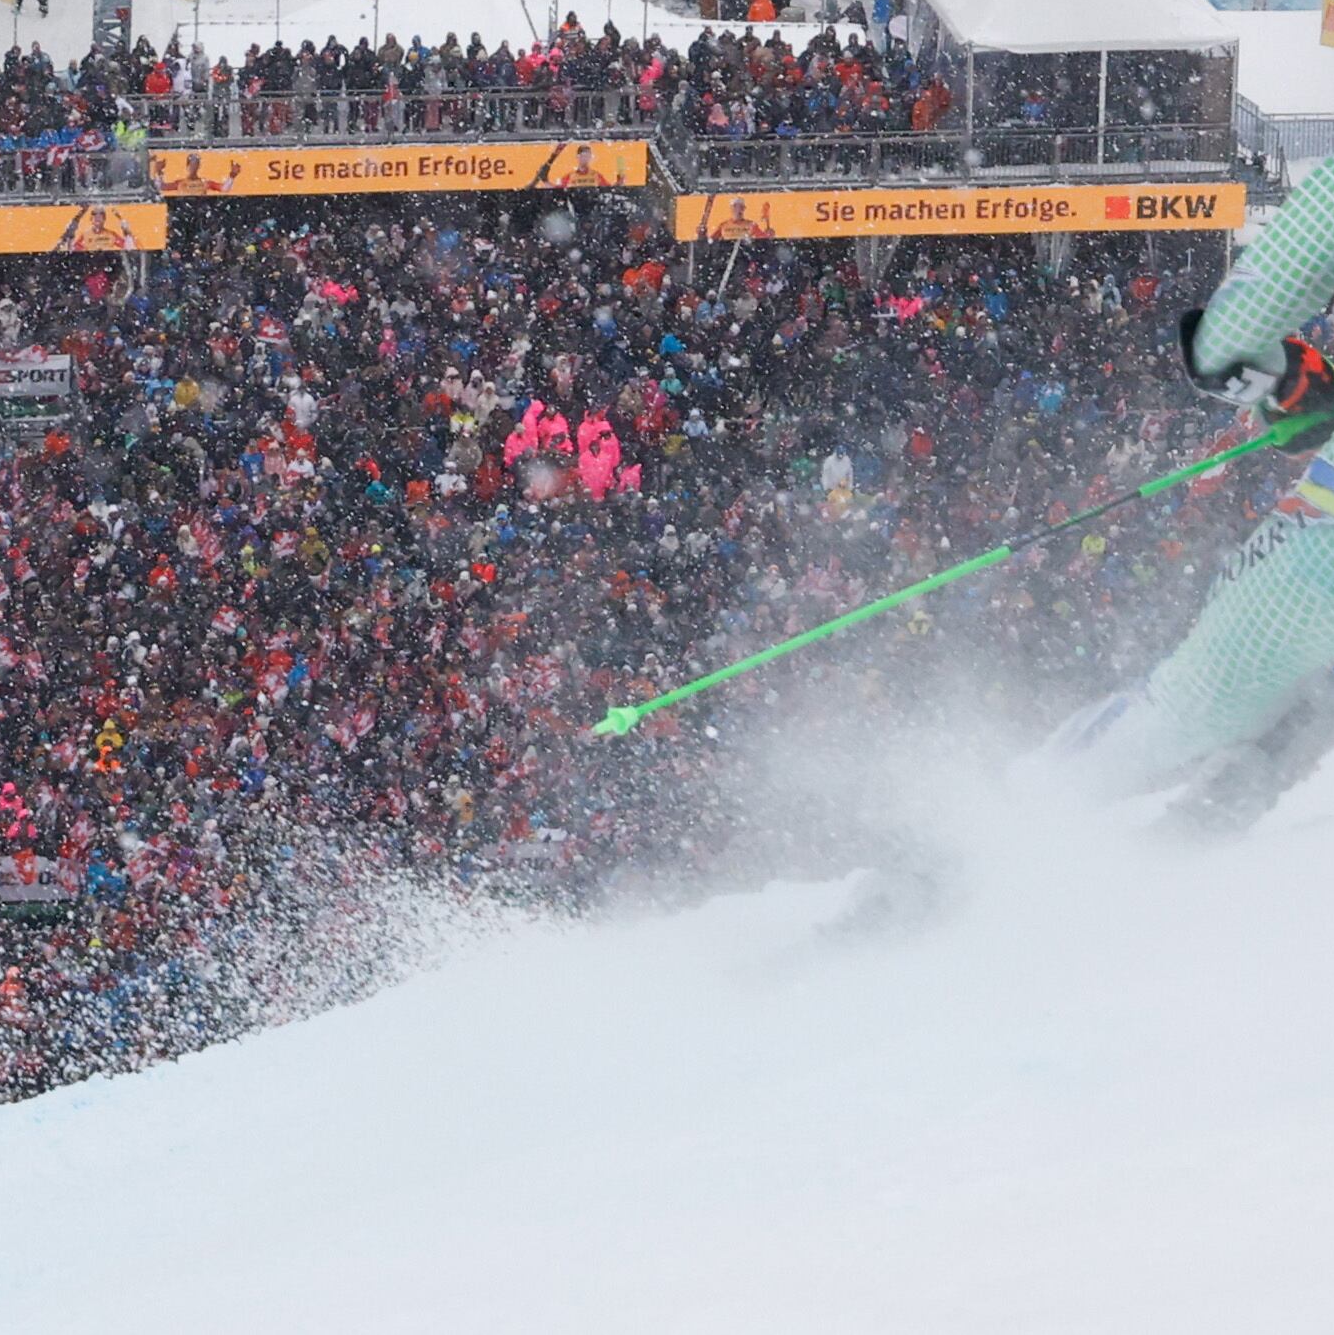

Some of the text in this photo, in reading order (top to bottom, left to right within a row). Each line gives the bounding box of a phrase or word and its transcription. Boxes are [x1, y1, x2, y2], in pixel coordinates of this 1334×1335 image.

[267, 155, 514, 180] Sie machen Erfolge.
[815, 197, 1077, 222] Sie machen Erfolge.
[1136, 194, 1217, 219] BKW
